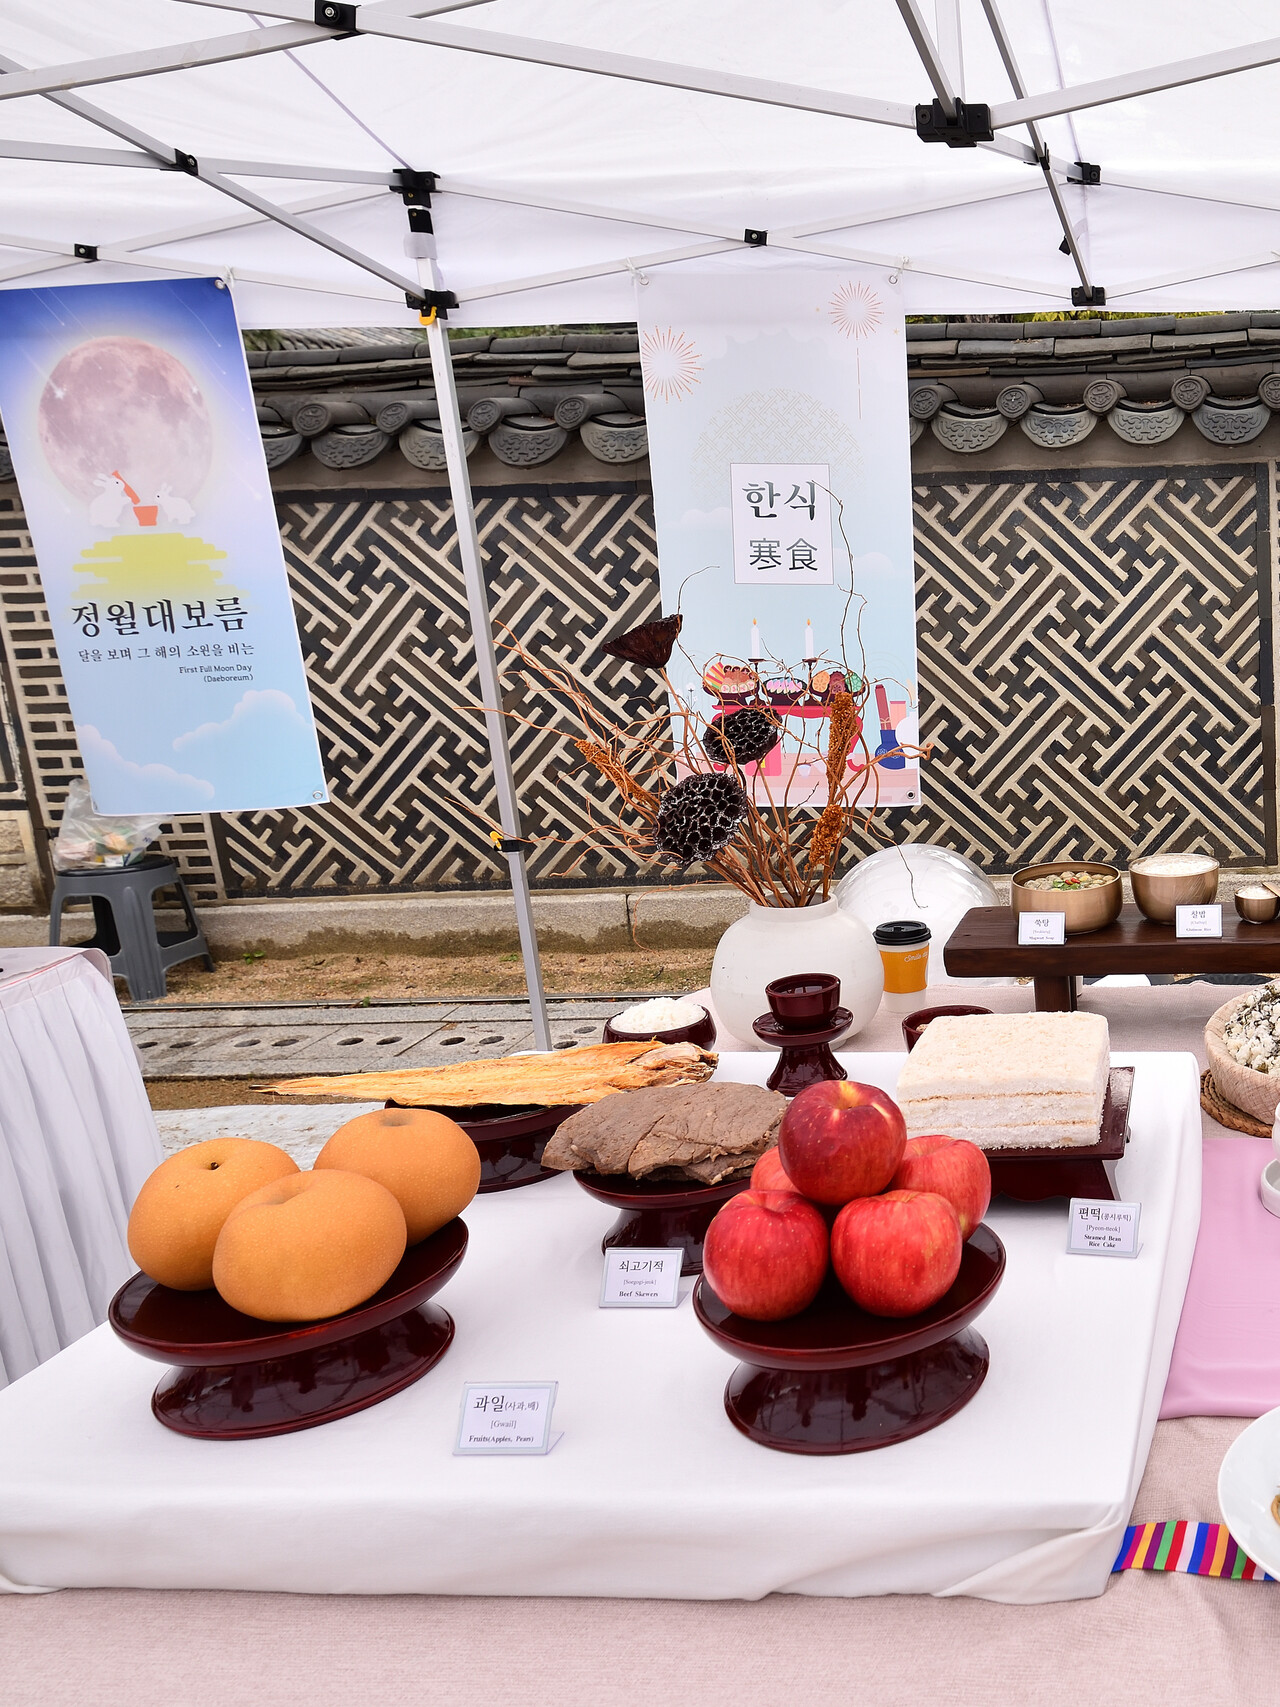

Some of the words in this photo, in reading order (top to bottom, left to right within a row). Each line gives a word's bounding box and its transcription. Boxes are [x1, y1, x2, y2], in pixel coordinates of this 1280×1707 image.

[742, 480, 816, 521] 한식
[750, 538, 818, 571] 寒食
[72, 597, 248, 638] 정월대보름
[79, 650, 102, 662] 달을
[107, 648, 132, 661] 보며
[138, 649, 151, 659] 그
[155, 646, 181, 658] 해의
[187, 644, 223, 657] 소원을
[228, 643, 254, 656] 비는
[179, 666, 198, 674] First
[200, 665, 212, 673] Full
[214, 665, 234, 673] Moon
[236, 664, 252, 674] Day
[204, 674, 253, 683] (Daeboreum)
[1034, 918, 1050, 927] 쑥탕
[619, 1260, 663, 1272] 쇠고기적
[491, 1420, 516, 1429] [Gwail]
